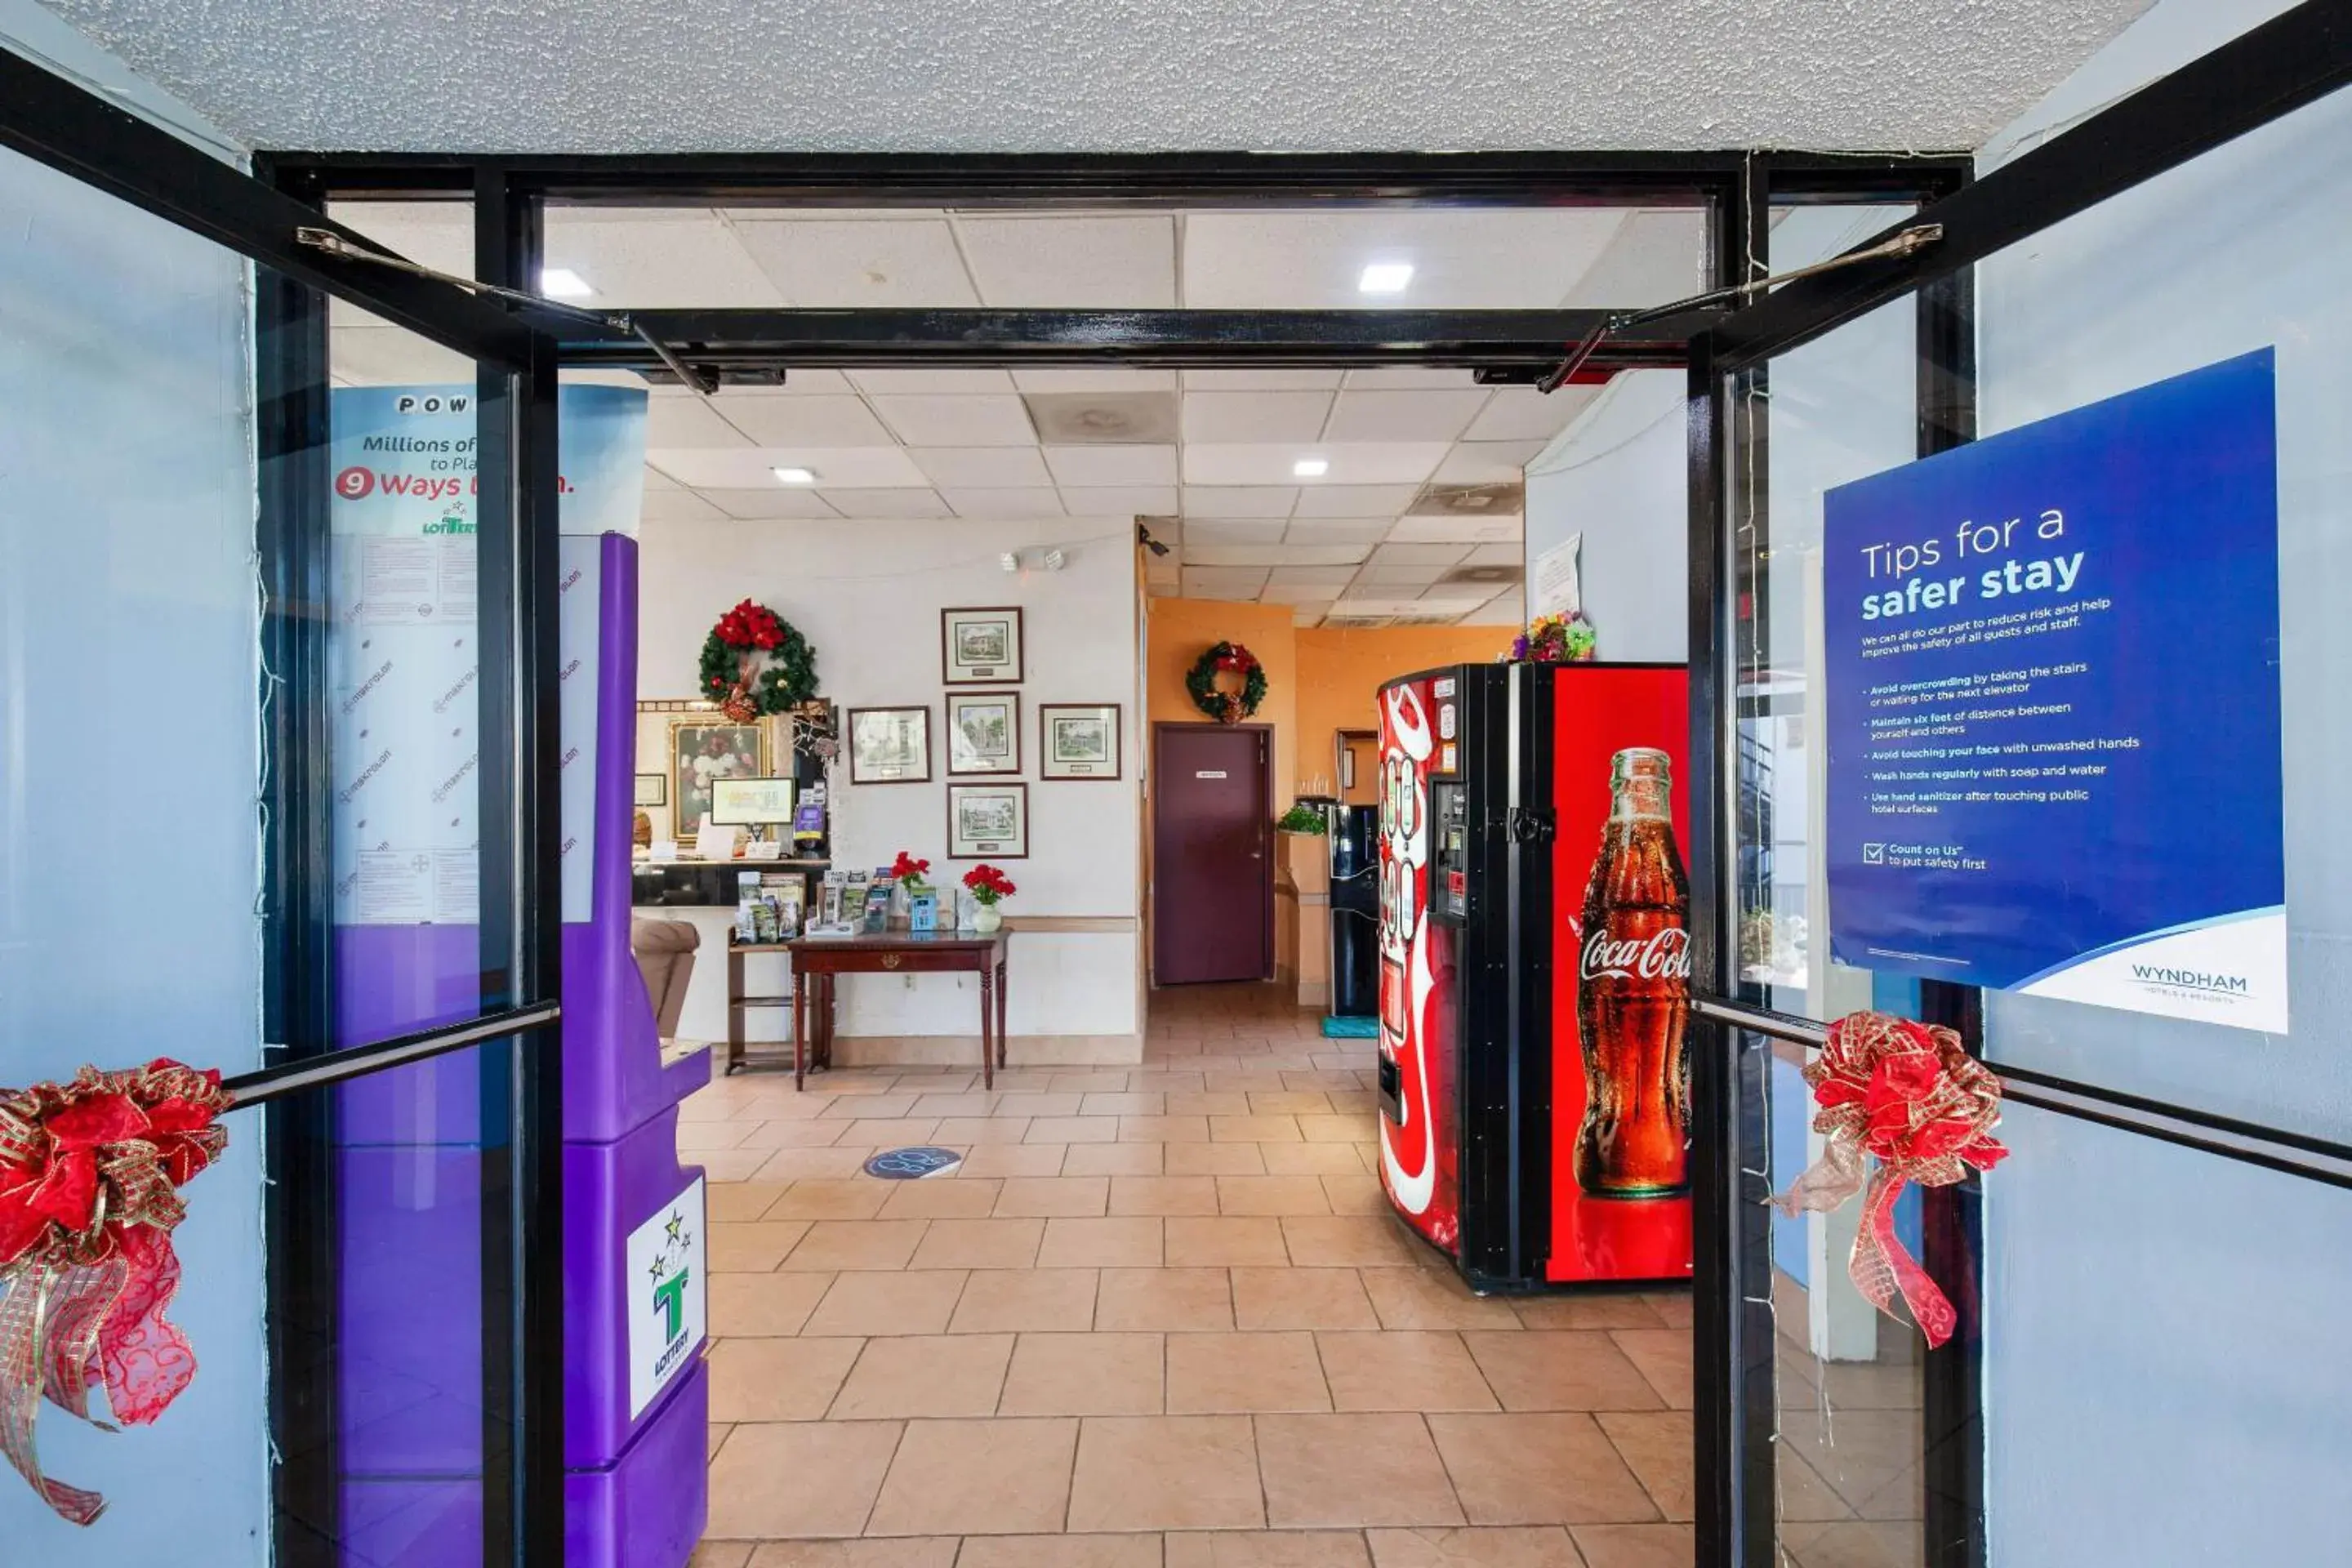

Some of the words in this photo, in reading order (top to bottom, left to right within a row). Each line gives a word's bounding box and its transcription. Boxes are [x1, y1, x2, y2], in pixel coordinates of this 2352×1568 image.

[399, 399, 466, 412] POW
[363, 437, 449, 452] Millions
[456, 437, 476, 452] of
[431, 459, 447, 470] to
[453, 458, 477, 470] Pla
[347, 469, 364, 492] 9
[381, 474, 461, 500] Ways
[423, 517, 476, 533] LOTTER
[1860, 540, 1940, 579] Tips
[1957, 518, 2020, 557] for
[2038, 510, 2063, 538] a
[1862, 576, 1965, 620] safer
[1980, 552, 2084, 598] stay
[1862, 638, 1878, 646] We
[1880, 635, 1896, 644] can
[1899, 630, 1909, 641] all
[1913, 629, 1926, 639] do
[1928, 626, 1945, 636] our
[1949, 621, 1970, 635] part
[1973, 620, 1984, 629] to
[1988, 613, 2026, 627] reduce
[2030, 607, 2051, 621] risk
[2055, 603, 2078, 617] and
[2082, 598, 2111, 612] help
[1862, 645, 1900, 658] improve
[1902, 641, 1918, 652] the
[1921, 635, 1950, 651] safety
[1955, 633, 1966, 644] of
[1969, 630, 1980, 642] all
[1984, 626, 2021, 641] guests
[2024, 620, 2047, 633] and
[2051, 617, 2081, 630] staff.
[1870, 684, 1898, 696] Avoid
[1900, 676, 1971, 692] overcrowding
[1974, 673, 1987, 684] by
[1990, 670, 2026, 684] taking
[2030, 665, 2050, 676] the
[2053, 662, 2087, 675] stairs
[1870, 698, 1880, 706] or
[1883, 694, 1918, 706] waiting
[1921, 691, 1935, 702] for
[1938, 689, 1954, 701] the
[1958, 688, 1980, 698] next
[1984, 684, 2030, 696] elevator
[1871, 716, 1911, 727] Maintain
[1914, 714, 1927, 724] six
[1931, 711, 1951, 723] feet
[1954, 710, 1966, 720] of
[1968, 707, 2015, 719] distance
[2018, 703, 2071, 715] between
[1871, 728, 1908, 740] yourself
[1910, 727, 1929, 736] and
[1931, 725, 1965, 735] others
[1872, 751, 1899, 760] Avoid
[1901, 748, 1945, 760] touching
[1949, 747, 1974, 758] your
[1976, 745, 1999, 755] face
[2003, 742, 2028, 753] with
[2031, 739, 2094, 752] unwashed
[2099, 737, 2140, 749] hands
[1873, 772, 1897, 781] Wash
[1900, 770, 1929, 780] hands
[1931, 768, 1979, 782] regularly
[1983, 768, 2007, 777] with
[2011, 768, 2038, 778] soap
[2042, 765, 2065, 775] and
[2069, 764, 2106, 774] water
[1872, 793, 1889, 801] Use
[1891, 792, 1915, 801] hand
[1918, 791, 1962, 801] sanitizer
[1966, 791, 1991, 800] after
[1994, 791, 2046, 802] touching
[2050, 790, 2088, 802] public
[1872, 804, 1895, 813] hotel
[1897, 804, 1938, 813] surfaces
[1889, 844, 1922, 854] Count
[1926, 847, 1938, 855] on
[1889, 858, 1901, 866] to
[1904, 858, 1922, 870] put
[1925, 858, 1959, 870] safety
[1962, 859, 1986, 870] first
[2132, 964, 2247, 991] WYNDHAM
[655, 1327, 689, 1377] LOTTERY
